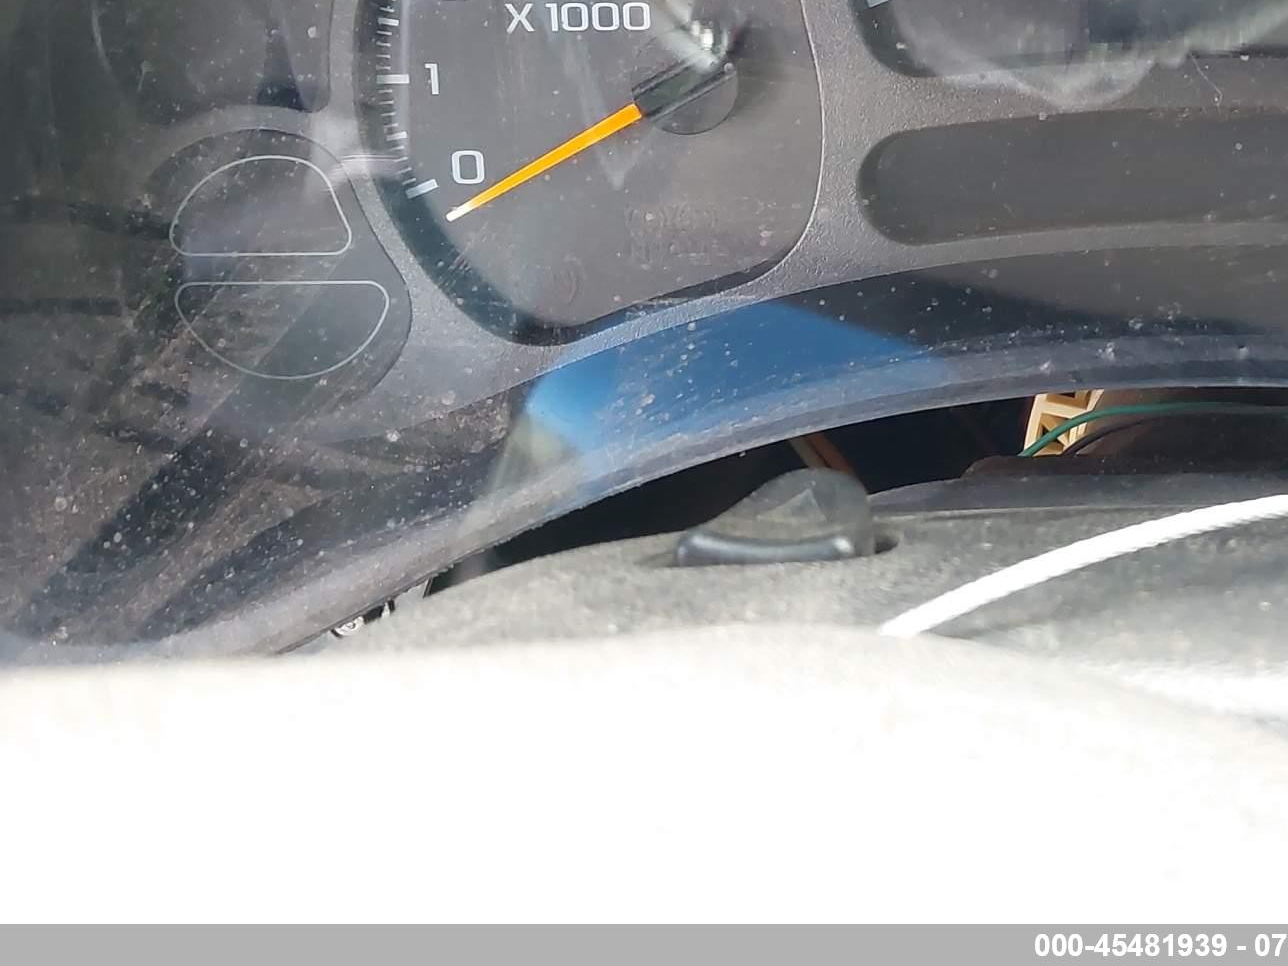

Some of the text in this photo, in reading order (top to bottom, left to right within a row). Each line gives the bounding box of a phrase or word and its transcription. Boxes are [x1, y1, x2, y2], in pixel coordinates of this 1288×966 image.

[504, 2, 651, 33] X 1000
[424, 63, 440, 95] 1
[451, 150, 485, 185] 0
